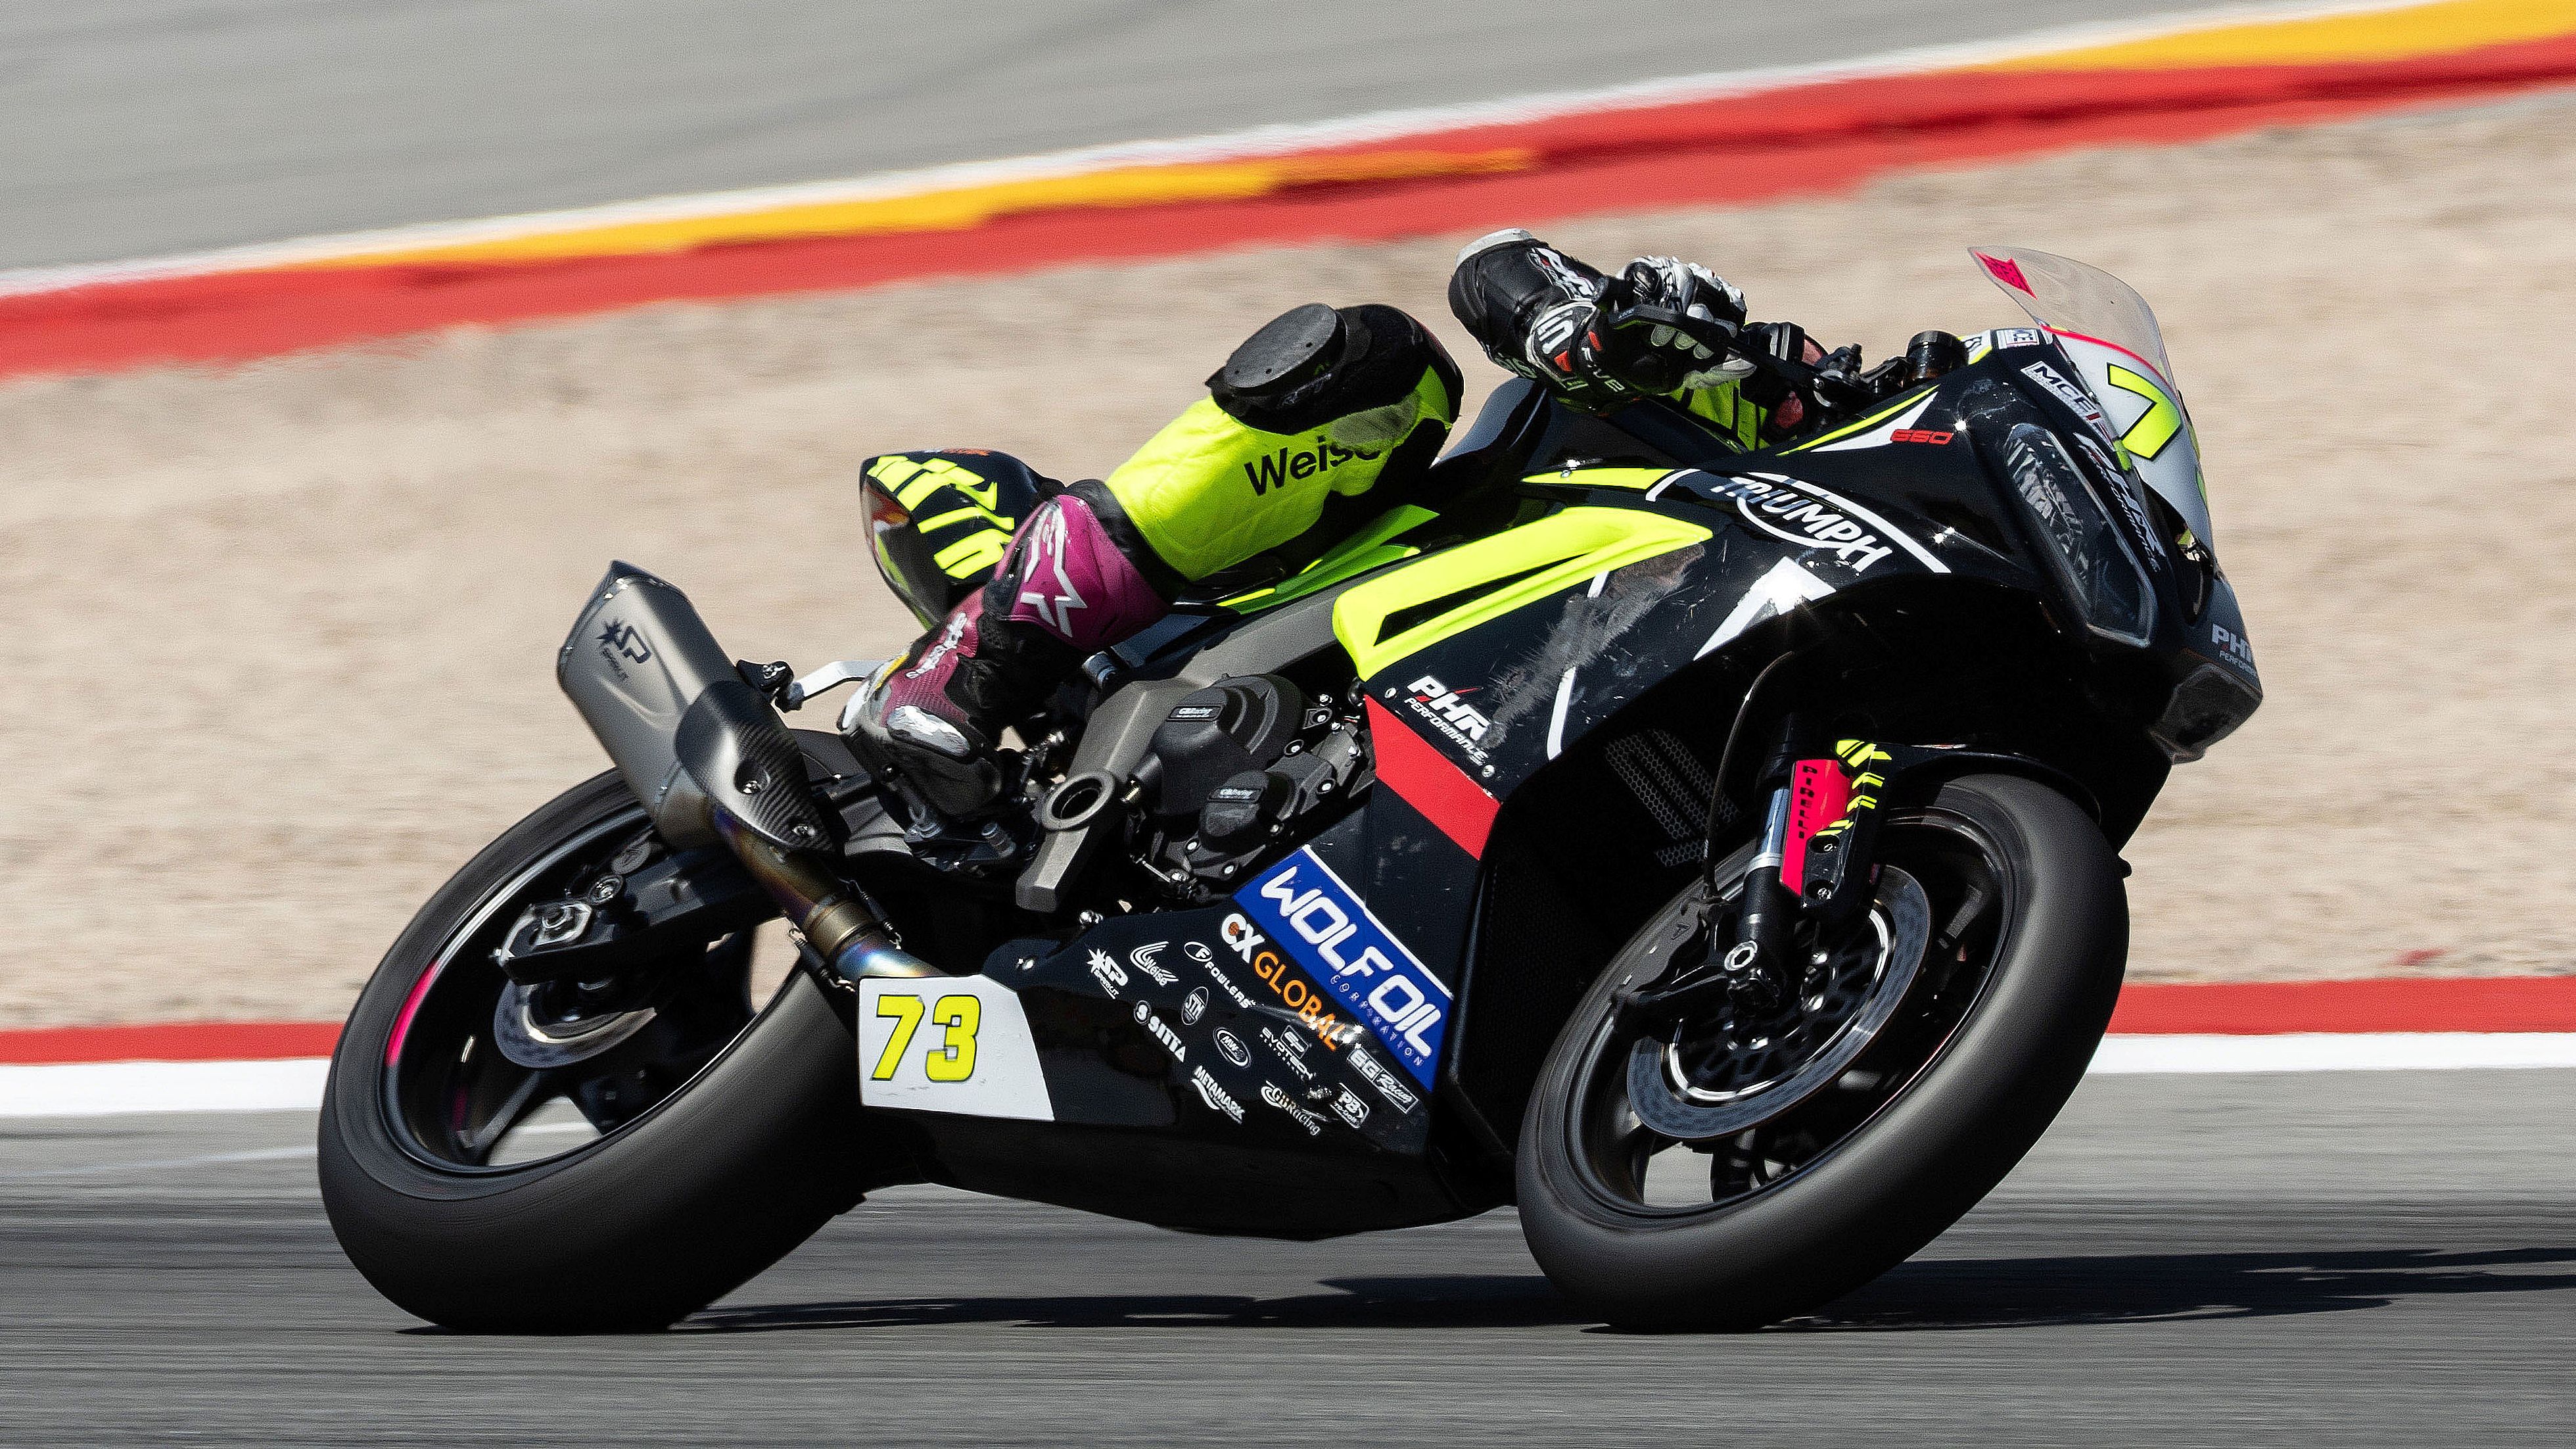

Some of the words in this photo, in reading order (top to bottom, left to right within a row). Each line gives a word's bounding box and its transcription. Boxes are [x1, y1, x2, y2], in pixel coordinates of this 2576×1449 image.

[2034, 366, 2097, 412] MCE
[1710, 477, 1893, 573] TRIUMPH
[1404, 697, 1489, 763] PERFORMANCE
[1407, 675, 1491, 742] PHR
[1796, 765, 1818, 840] PIRELLI
[1144, 956, 1168, 986] Weise
[1204, 961, 1252, 1009] FOWLERS
[1221, 913, 1265, 964] CX
[1254, 951, 1346, 1052] GLOBAL
[1261, 866, 1394, 977] WOLF
[1368, 974, 1441, 1058] OIL
[871, 994, 981, 1083] 73
[1262, 1027, 1313, 1080] EVOTECH
[1330, 974, 1424, 1066] CORPORATION
[1194, 1065, 1246, 1121] METAMARK
